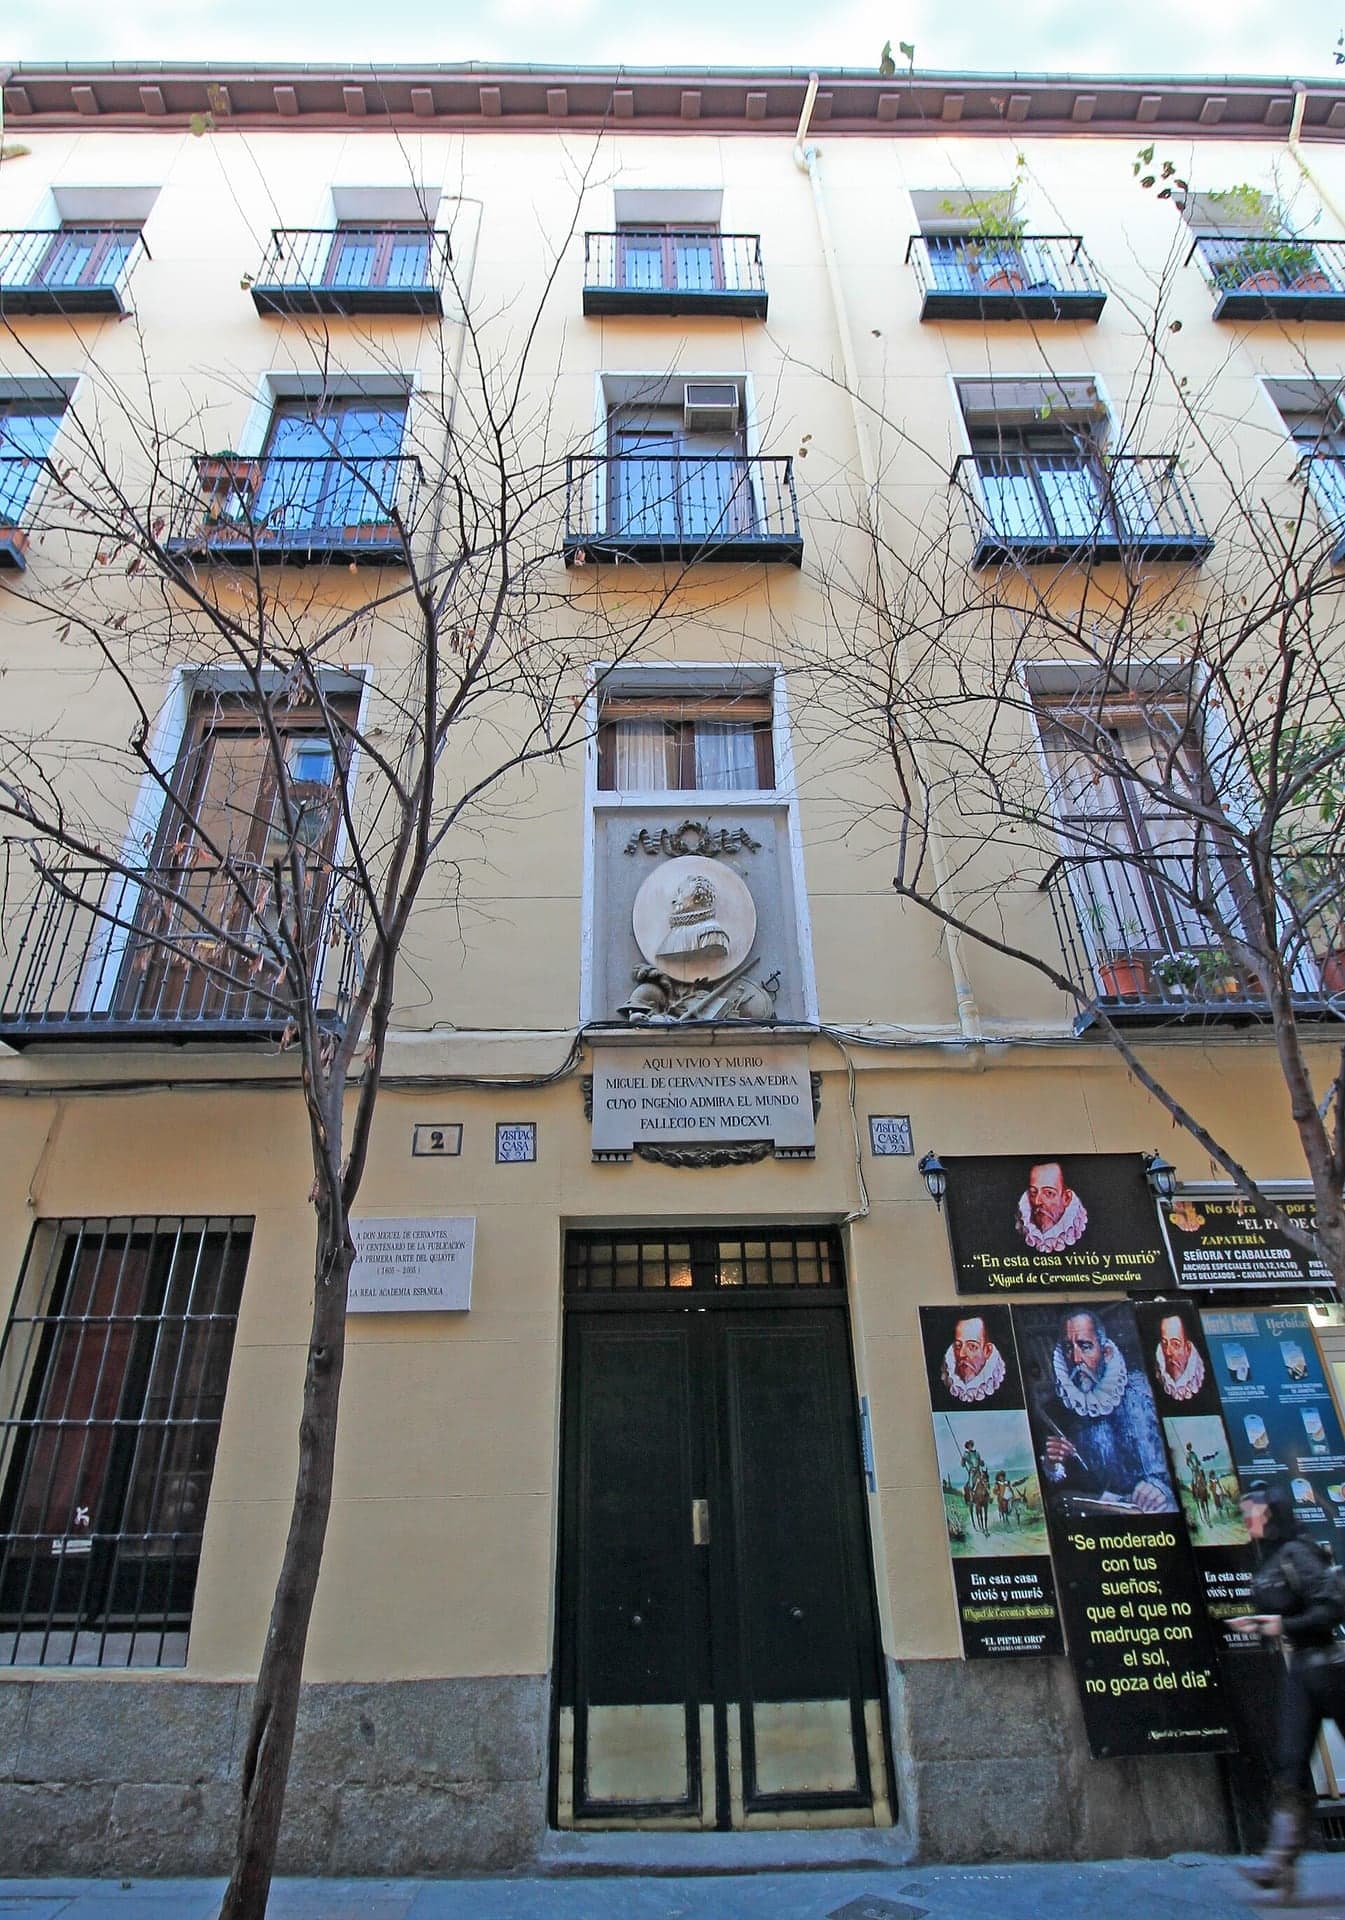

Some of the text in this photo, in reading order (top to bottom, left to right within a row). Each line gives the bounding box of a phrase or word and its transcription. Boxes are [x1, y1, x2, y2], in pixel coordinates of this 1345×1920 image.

[642, 1057, 763, 1071] AQUI VIVIO Y MURIO
[606, 1076, 797, 1089] MIGUEL DE CERVANTES SAAVEDRA
[606, 1095, 799, 1110] CUYO INGENIO ADMIRA EL MUNDO
[640, 1117, 696, 1129] FALLECIO
[698, 1116, 716, 1128] EN
[431, 1131, 444, 1149] 2
[878, 1134, 904, 1144] CASA
[502, 1142, 529, 1152] CASA
[1205, 1204, 1223, 1214] No
[1227, 1204, 1256, 1214] sura
[1286, 1204, 1306, 1215] por
[1003, 1255, 1029, 1268] esta
[1033, 1255, 1062, 1266] casa
[1065, 1251, 1100, 1265] vivió
[1103, 1254, 1111, 1268] y
[1184, 1249, 1291, 1261] SEÑORA Y CABALLERO
[1183, 1263, 1210, 1271] ANCHOS
[1211, 1262, 1252, 1271] ESPECIALES
[989, 1271, 1142, 1287] Miguel de Cervantes Saavedra
[1199, 1271, 1236, 1280] DELICADOS
[1268, 1270, 1304, 1278] PLANTILLA
[1099, 1531, 1176, 1549] moderado
[1101, 1555, 1157, 1572] con tus
[970, 1573, 1038, 1585] En esta casa
[1101, 1578, 1162, 1595] sueños;
[970, 1586, 1044, 1601] vivió y murió
[1086, 1604, 1116, 1623] que
[1120, 1601, 1134, 1618] el
[1138, 1603, 1168, 1621] que
[1171, 1602, 1192, 1616] no
[1090, 1626, 1193, 1645] madruga con
[1123, 1648, 1170, 1667] el sol,
[1085, 1679, 1106, 1693] no
[1110, 1676, 1149, 1696] goza
[1153, 1672, 1177, 1690] del
